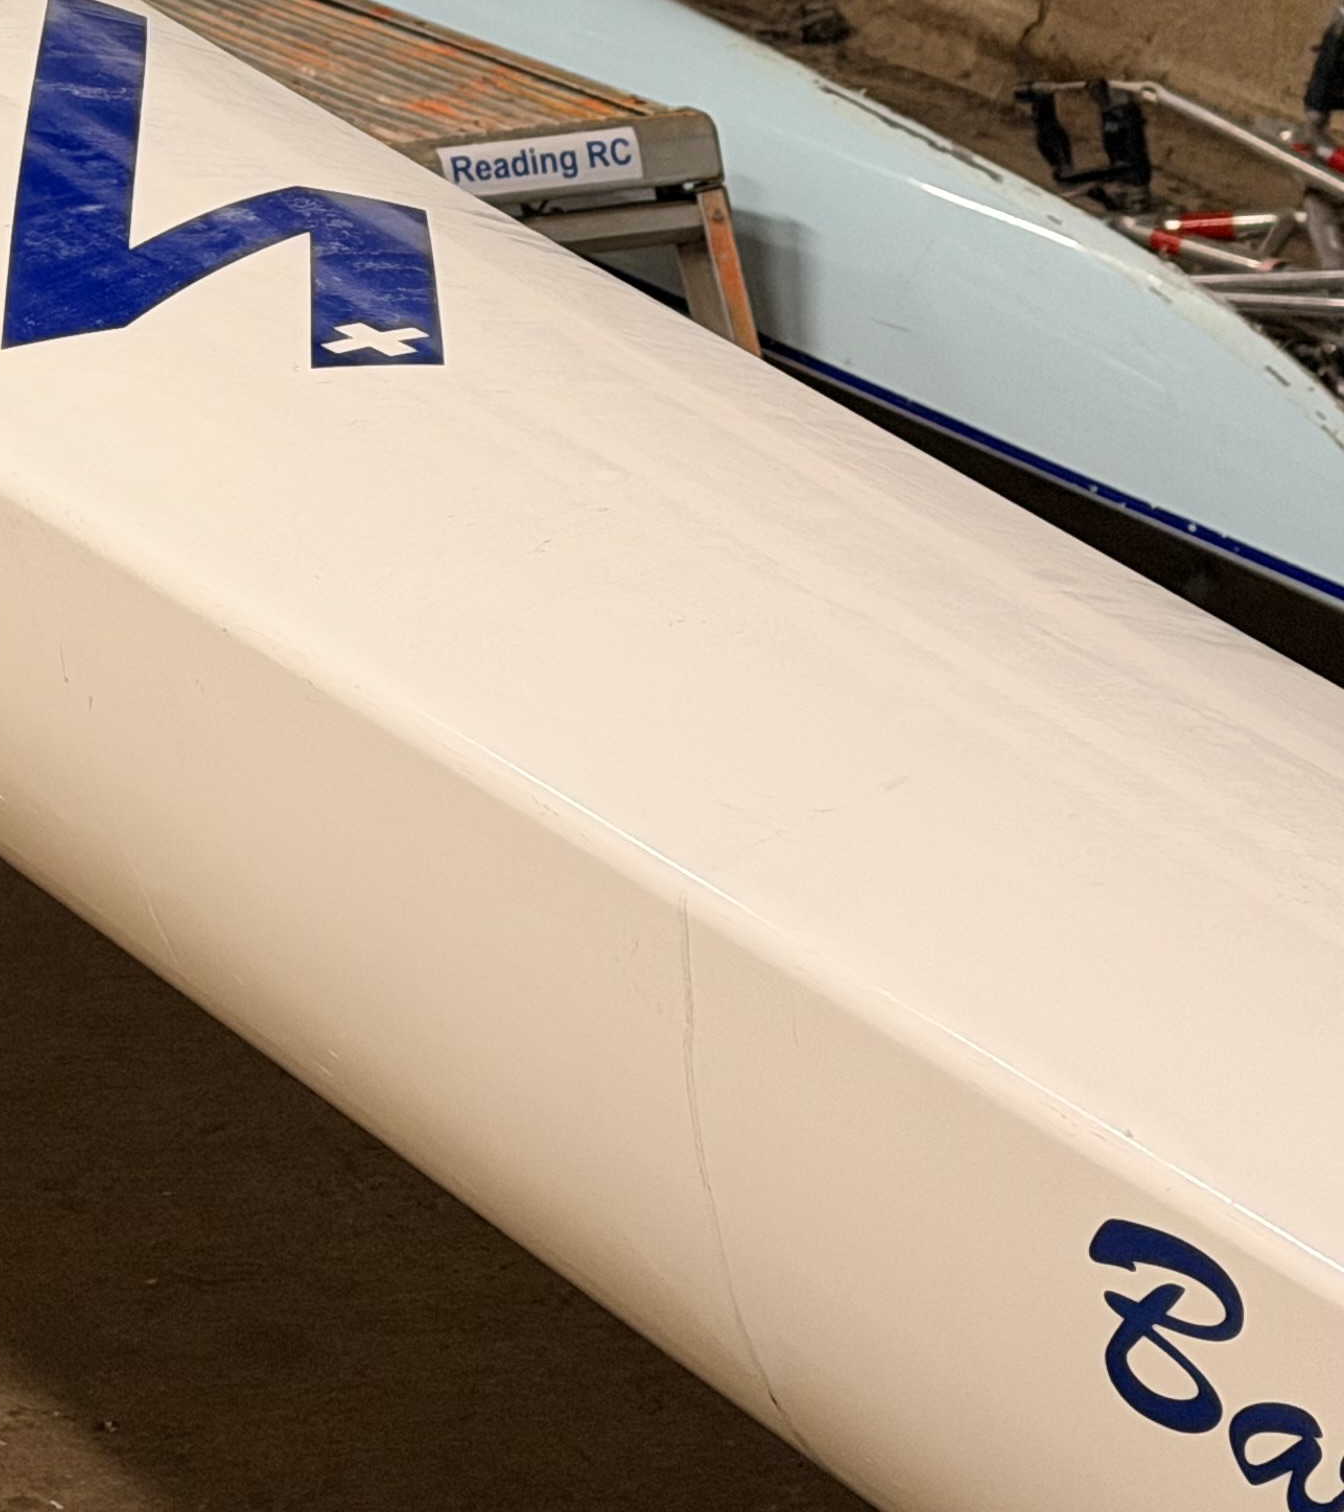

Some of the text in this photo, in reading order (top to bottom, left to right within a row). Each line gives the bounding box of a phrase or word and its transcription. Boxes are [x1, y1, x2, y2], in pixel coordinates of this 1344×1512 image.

[450, 137, 632, 184] Reading RC
[1088, 1218, 1344, 1512] Ba
